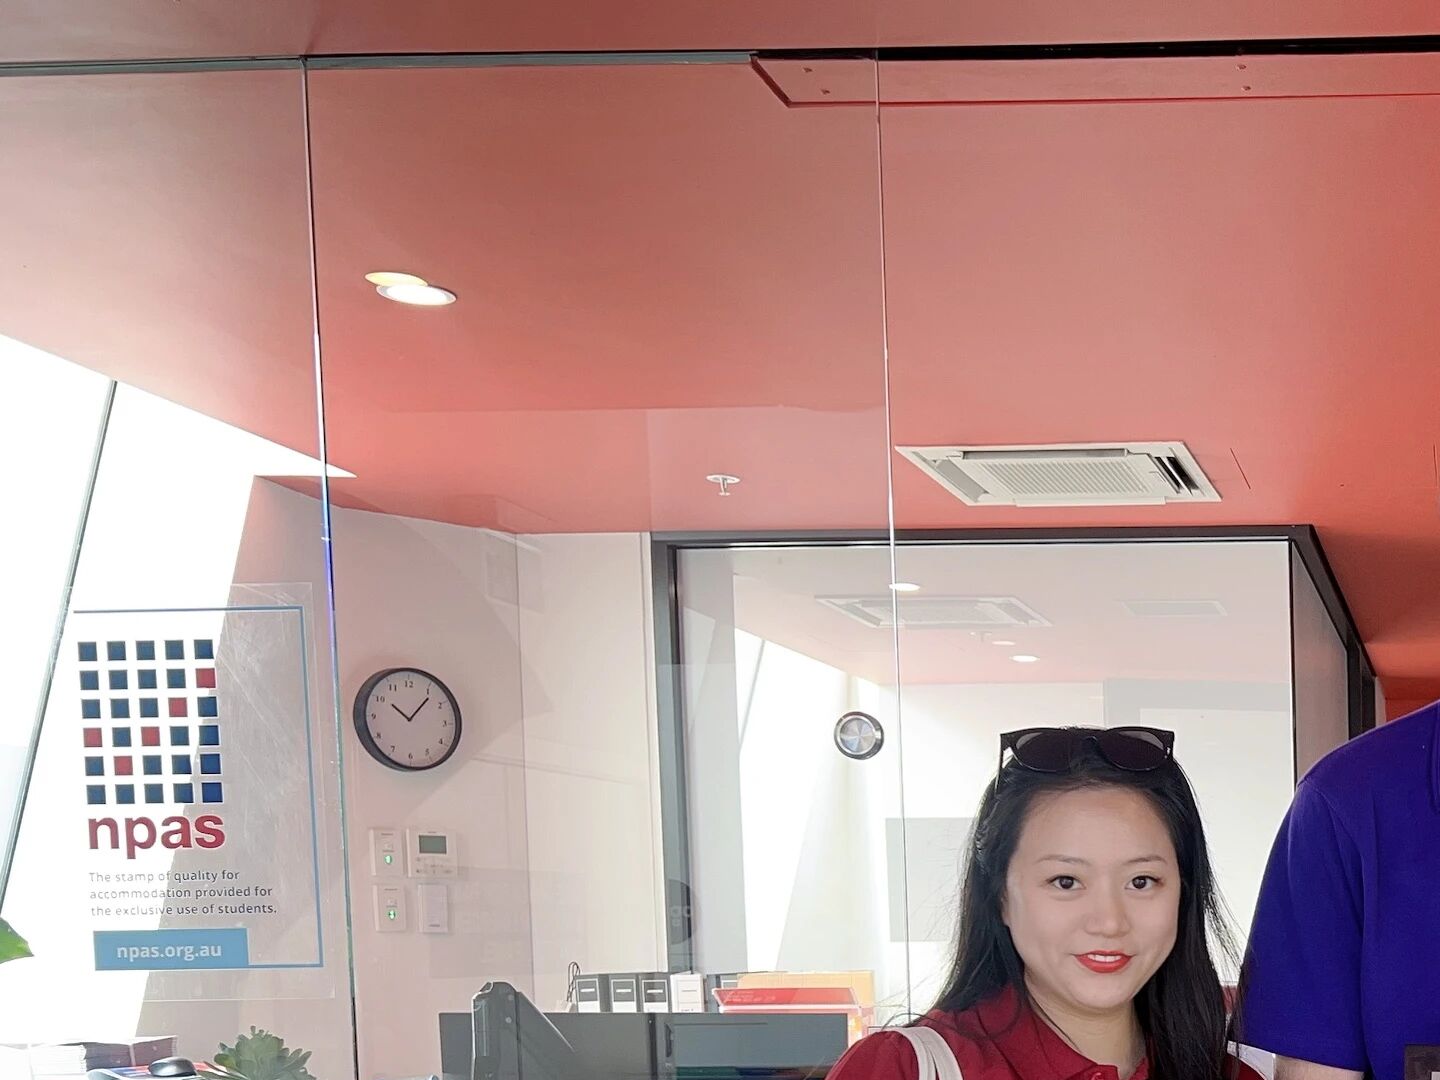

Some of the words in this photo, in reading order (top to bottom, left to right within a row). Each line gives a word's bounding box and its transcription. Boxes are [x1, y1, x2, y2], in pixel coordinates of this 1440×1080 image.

[88, 815, 225, 859] npas
[89, 872, 111, 882] The
[115, 871, 154, 883] stamp
[159, 870, 171, 880] of
[174, 870, 218, 883] quality
[221, 870, 239, 880] for
[90, 888, 191, 899] accommodation
[196, 886, 250, 899] provided
[254, 886, 272, 896] for
[91, 906, 111, 916] the
[116, 904, 172, 915] exclusive
[177, 905, 198, 914] use
[202, 903, 214, 913] of
[218, 903, 276, 914] students.
[117, 945, 221, 962] npas.org.au
